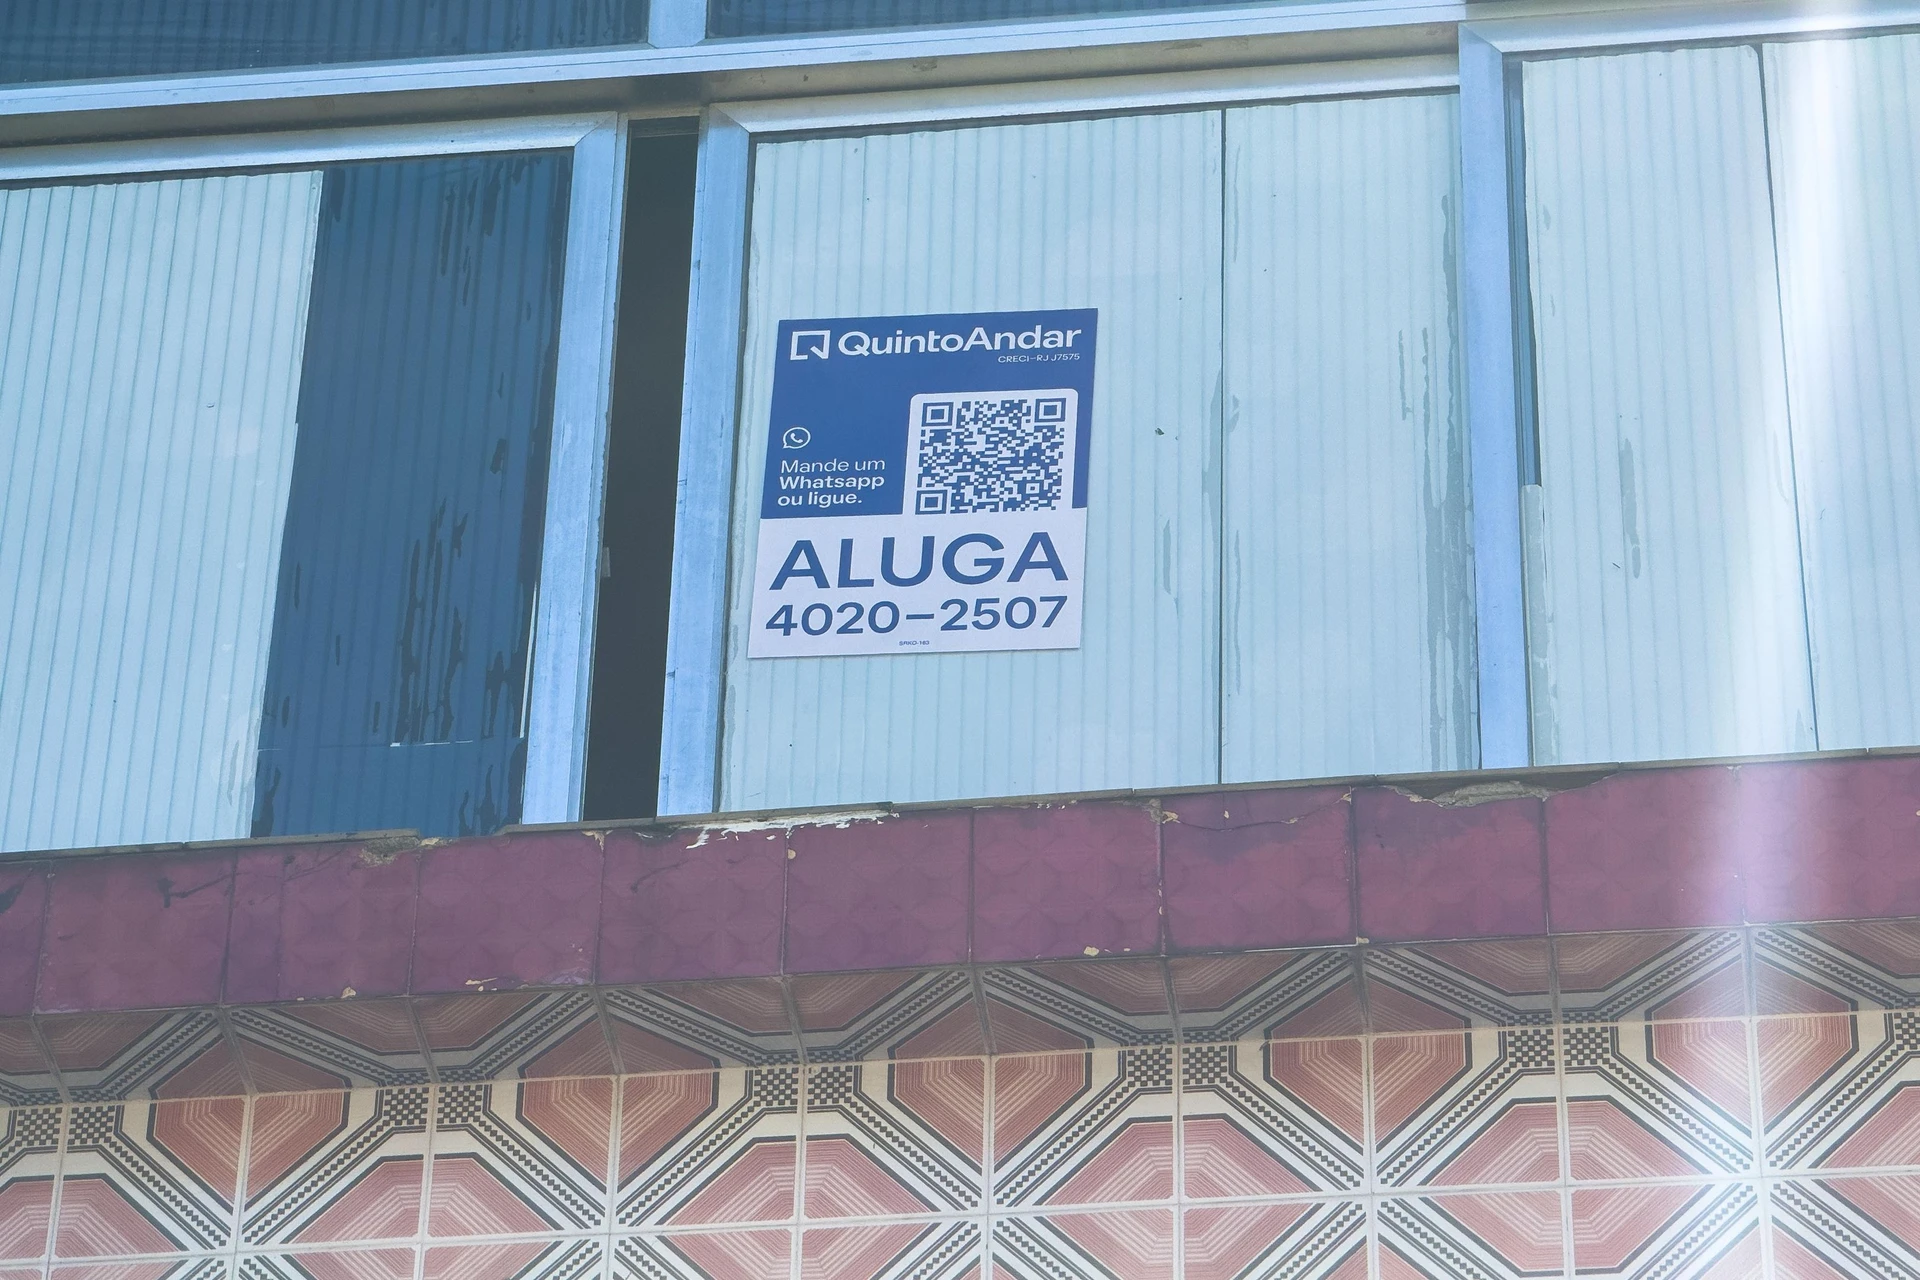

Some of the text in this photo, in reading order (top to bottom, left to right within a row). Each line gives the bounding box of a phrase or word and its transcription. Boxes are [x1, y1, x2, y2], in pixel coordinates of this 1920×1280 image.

[838, 325, 1082, 357] QuintoAndar
[997, 353, 1081, 363] CRECI-RJ J7575
[781, 458, 885, 473] Mande um
[779, 475, 885, 490] Whatsapp
[777, 491, 862, 508] ou ligue.
[769, 531, 1069, 590] ALUGA
[765, 595, 1068, 636] 4020-2507
